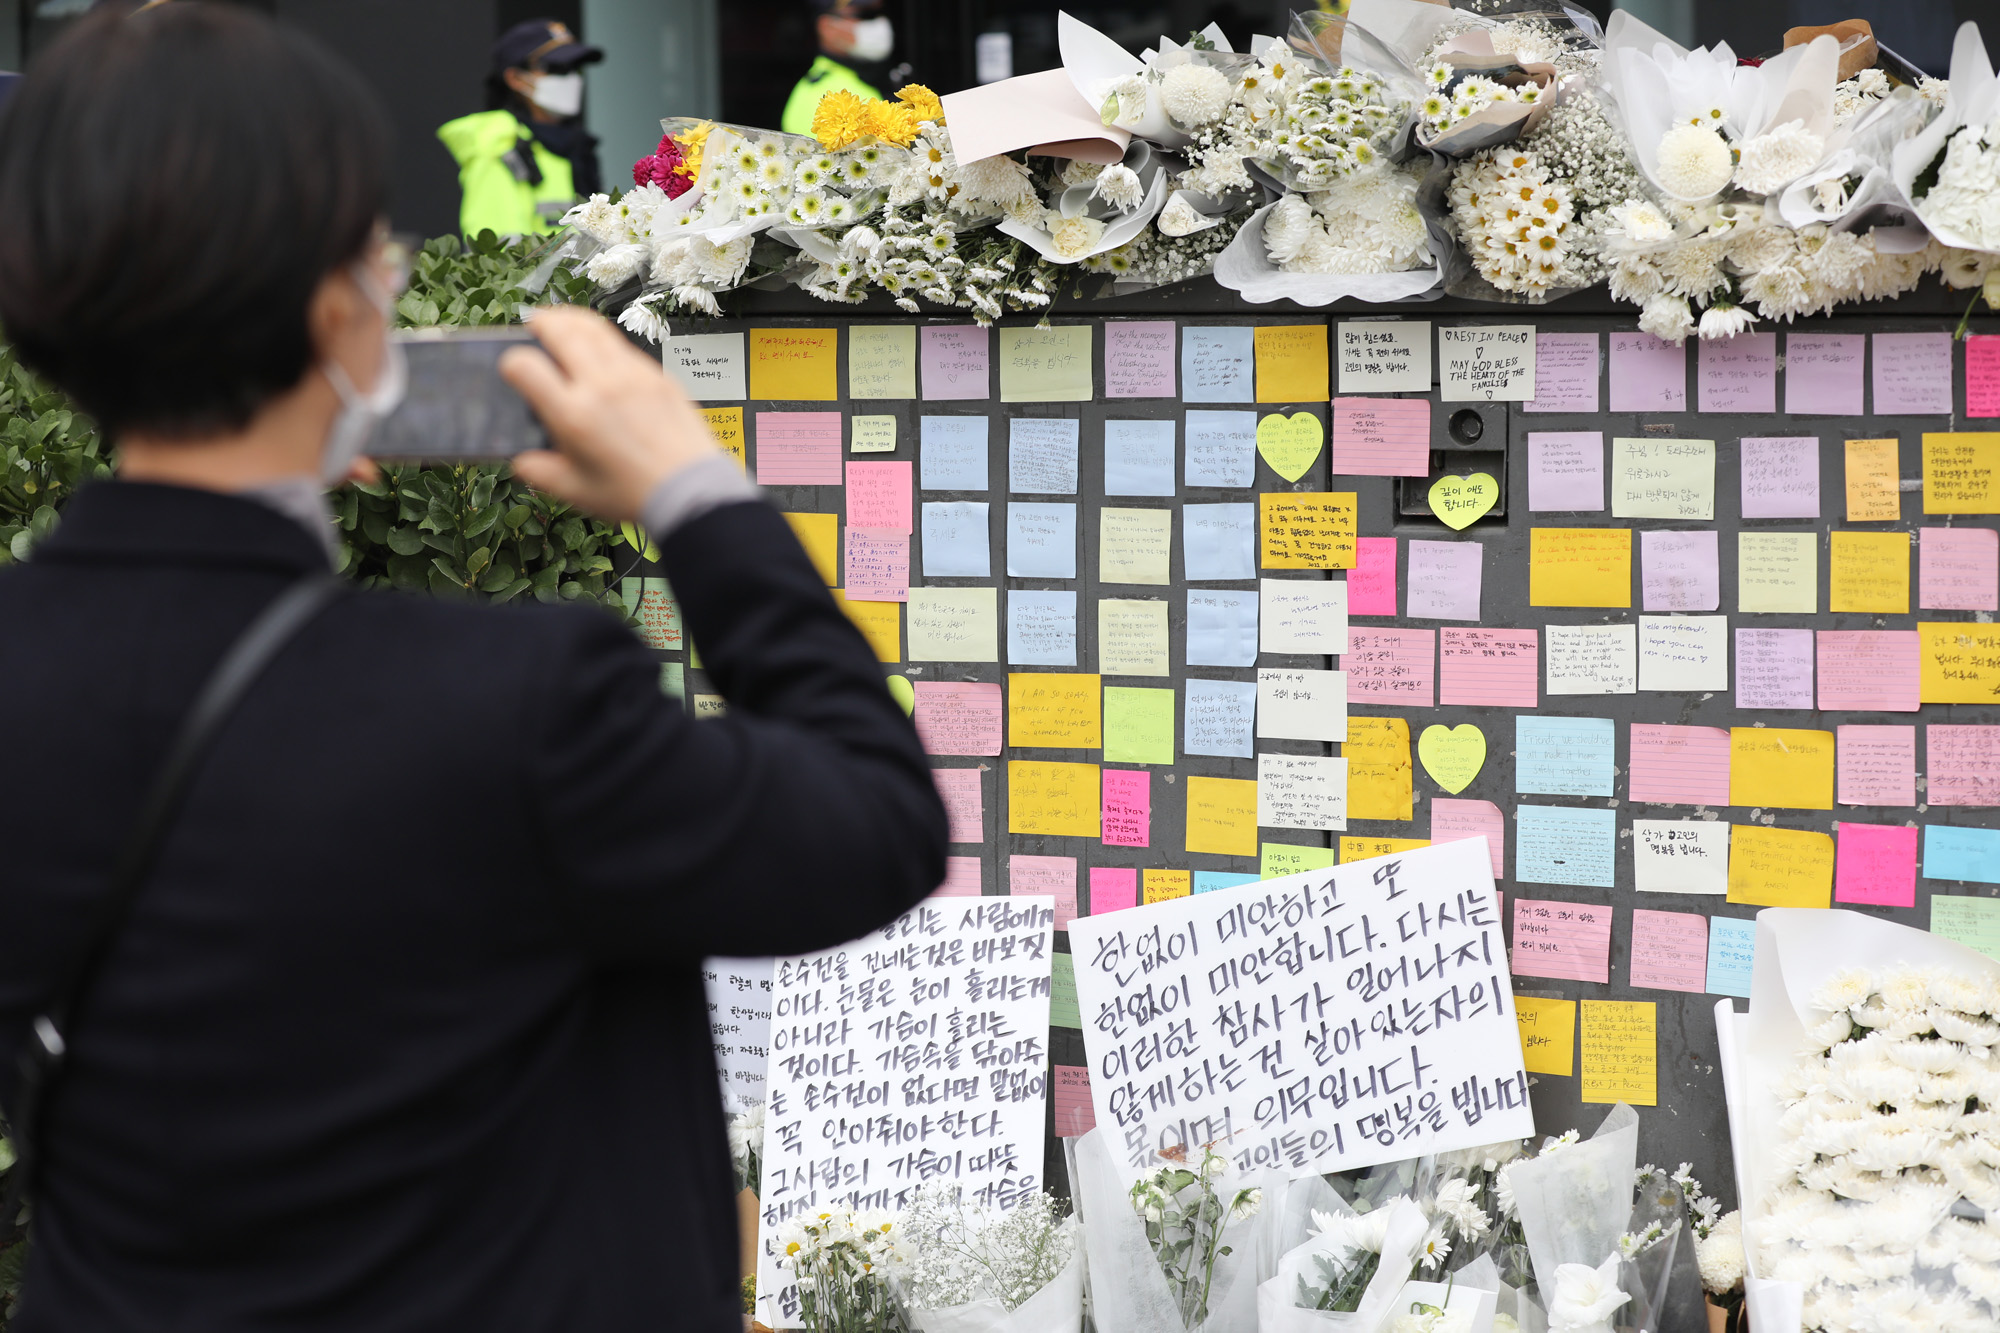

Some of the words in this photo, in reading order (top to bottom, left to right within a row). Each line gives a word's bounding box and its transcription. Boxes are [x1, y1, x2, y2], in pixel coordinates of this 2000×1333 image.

[1453, 330, 1476, 343] REST
[1477, 332, 1494, 343] IN
[1498, 331, 1521, 343] PEACE
[1345, 361, 1362, 374] 고인의
[1450, 359, 1470, 372] MAY
[1471, 358, 1492, 372] GOD
[1494, 356, 1519, 369] BLESS
[1450, 370, 1468, 381] THE
[1470, 368, 1498, 381] HEARTS
[1498, 367, 1511, 379] OF
[1511, 367, 1526, 377] THE
[1439, 486, 1461, 498] 깊이
[1465, 484, 1484, 495] 애도
[1624, 469, 1671, 481] 위로하시고
[1648, 637, 1667, 647] hope
[1668, 640, 1686, 649] you
[1641, 828, 1664, 843] 삼가
[1758, 839, 1773, 848] THE
[1749, 860, 1770, 872] REST
[1774, 863, 1784, 873] IN
[958, 901, 1054, 934] 사람에게
[1090, 919, 1199, 988] 한없이
[1215, 877, 1346, 944] 미안하고
[1372, 858, 1409, 902] 또
[778, 951, 851, 989] 손수건을
[972, 931, 1046, 965] 바보짓
[1093, 973, 1191, 1041] 한없이
[1207, 913, 1388, 997] 미안합니다.
[1396, 888, 1500, 944] 다시는
[776, 988, 830, 1018] 이다.
[837, 977, 898, 1017] 눈물은
[909, 975, 952, 1006] 눈이
[964, 967, 1051, 1004] 흘리는게
[1101, 1016, 1202, 1081] 이러한
[1211, 980, 1336, 1050] 참사가
[1345, 929, 1493, 1004] 일어나지
[774, 1017, 854, 1052] 아니라
[868, 1010, 941, 1043] 가슴이
[945, 1006, 1018, 1046] 흘리는
[778, 1048, 864, 1083] 것이다.
[875, 1038, 963, 1073] 가슴속을
[970, 1035, 1046, 1071] 닦아주
[769, 1089, 789, 1117] 는
[803, 1080, 891, 1113] 손수건이
[900, 1073, 981, 1108] 없다면
[988, 1067, 1048, 1103] 말없이
[775, 1119, 804, 1157] 꼭
[1230, 1121, 1346, 1172] 고인들의
[1355, 1090, 1450, 1148] 명복을
[1450, 1069, 1528, 1128] 빕니다
[886, 1147, 963, 1183] 가슴이
[968, 1143, 1019, 1175] 따뜻
[972, 1175, 1040, 1211] 가슴을
